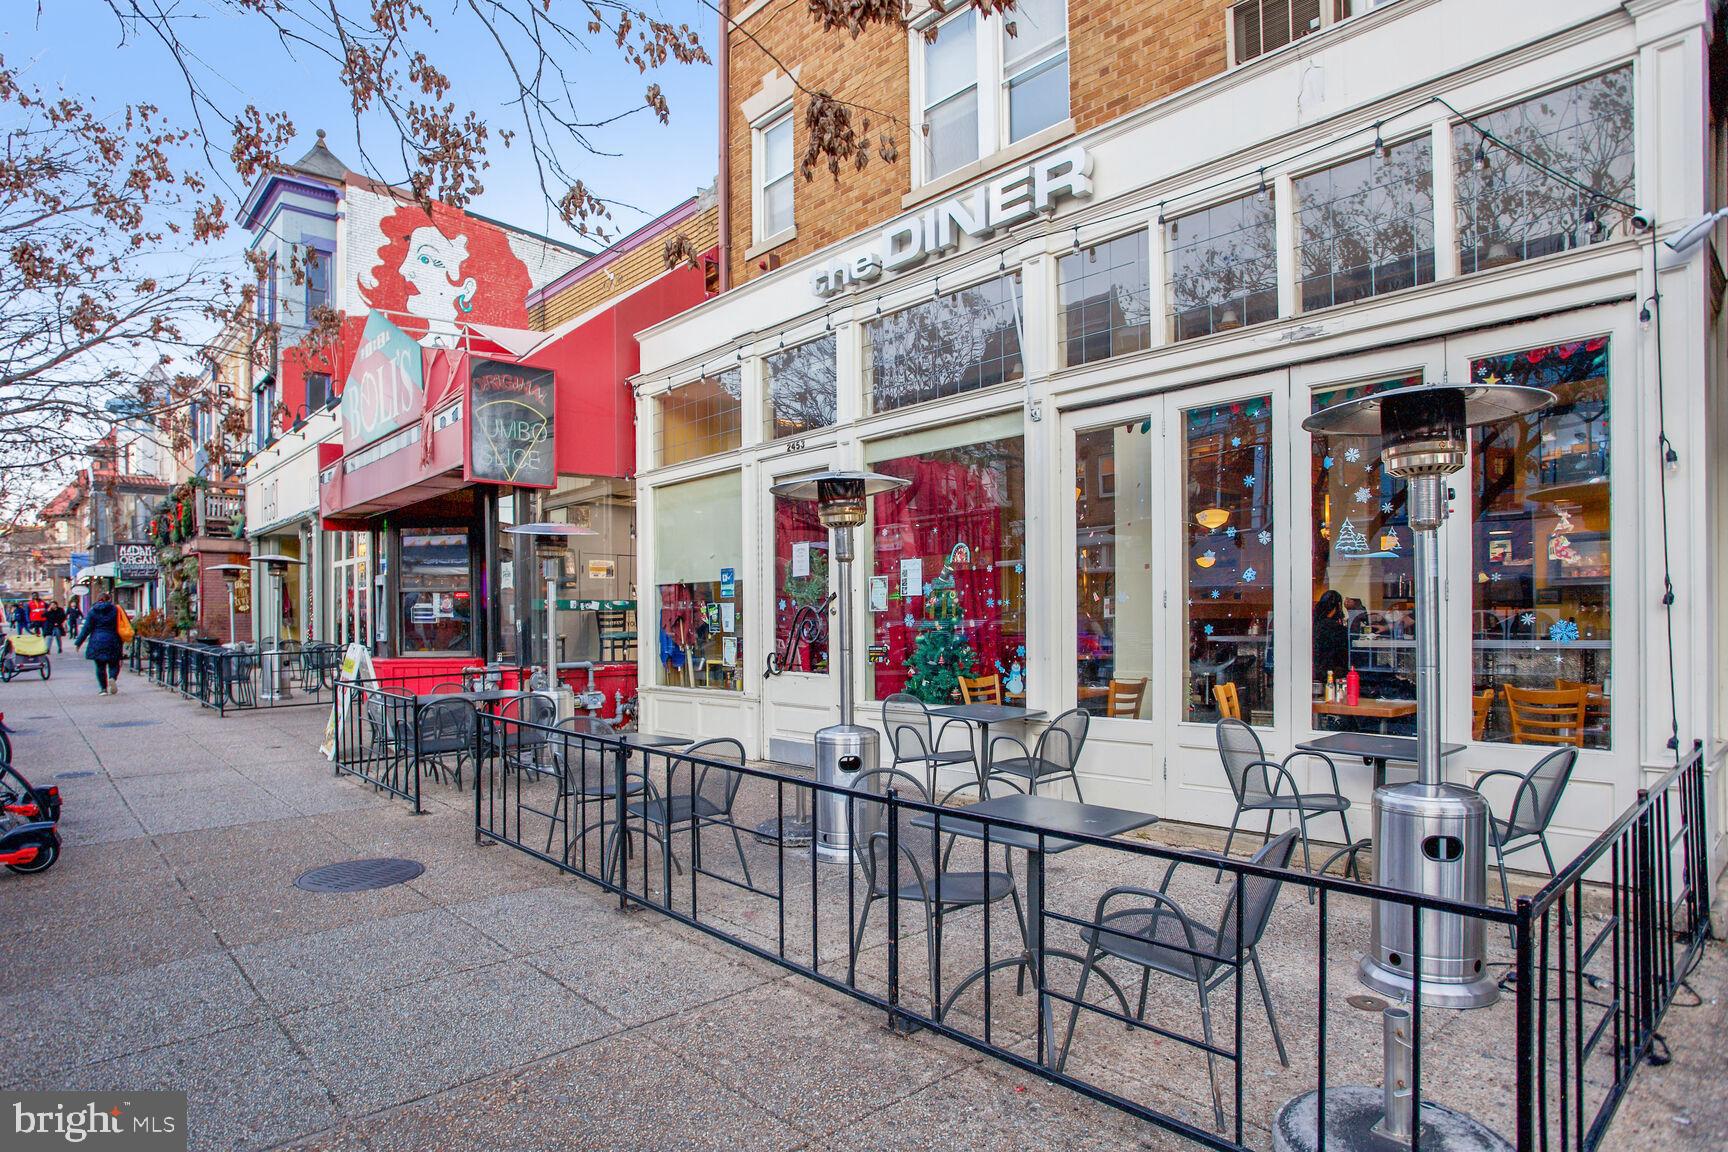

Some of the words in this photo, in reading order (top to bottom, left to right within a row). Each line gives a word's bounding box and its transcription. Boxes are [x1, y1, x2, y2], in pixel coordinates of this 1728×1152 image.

[811, 252, 882, 297] the
[881, 146, 1094, 272] DINER
[348, 348, 414, 441] BOLI'S
[786, 440, 805, 453] 2453
